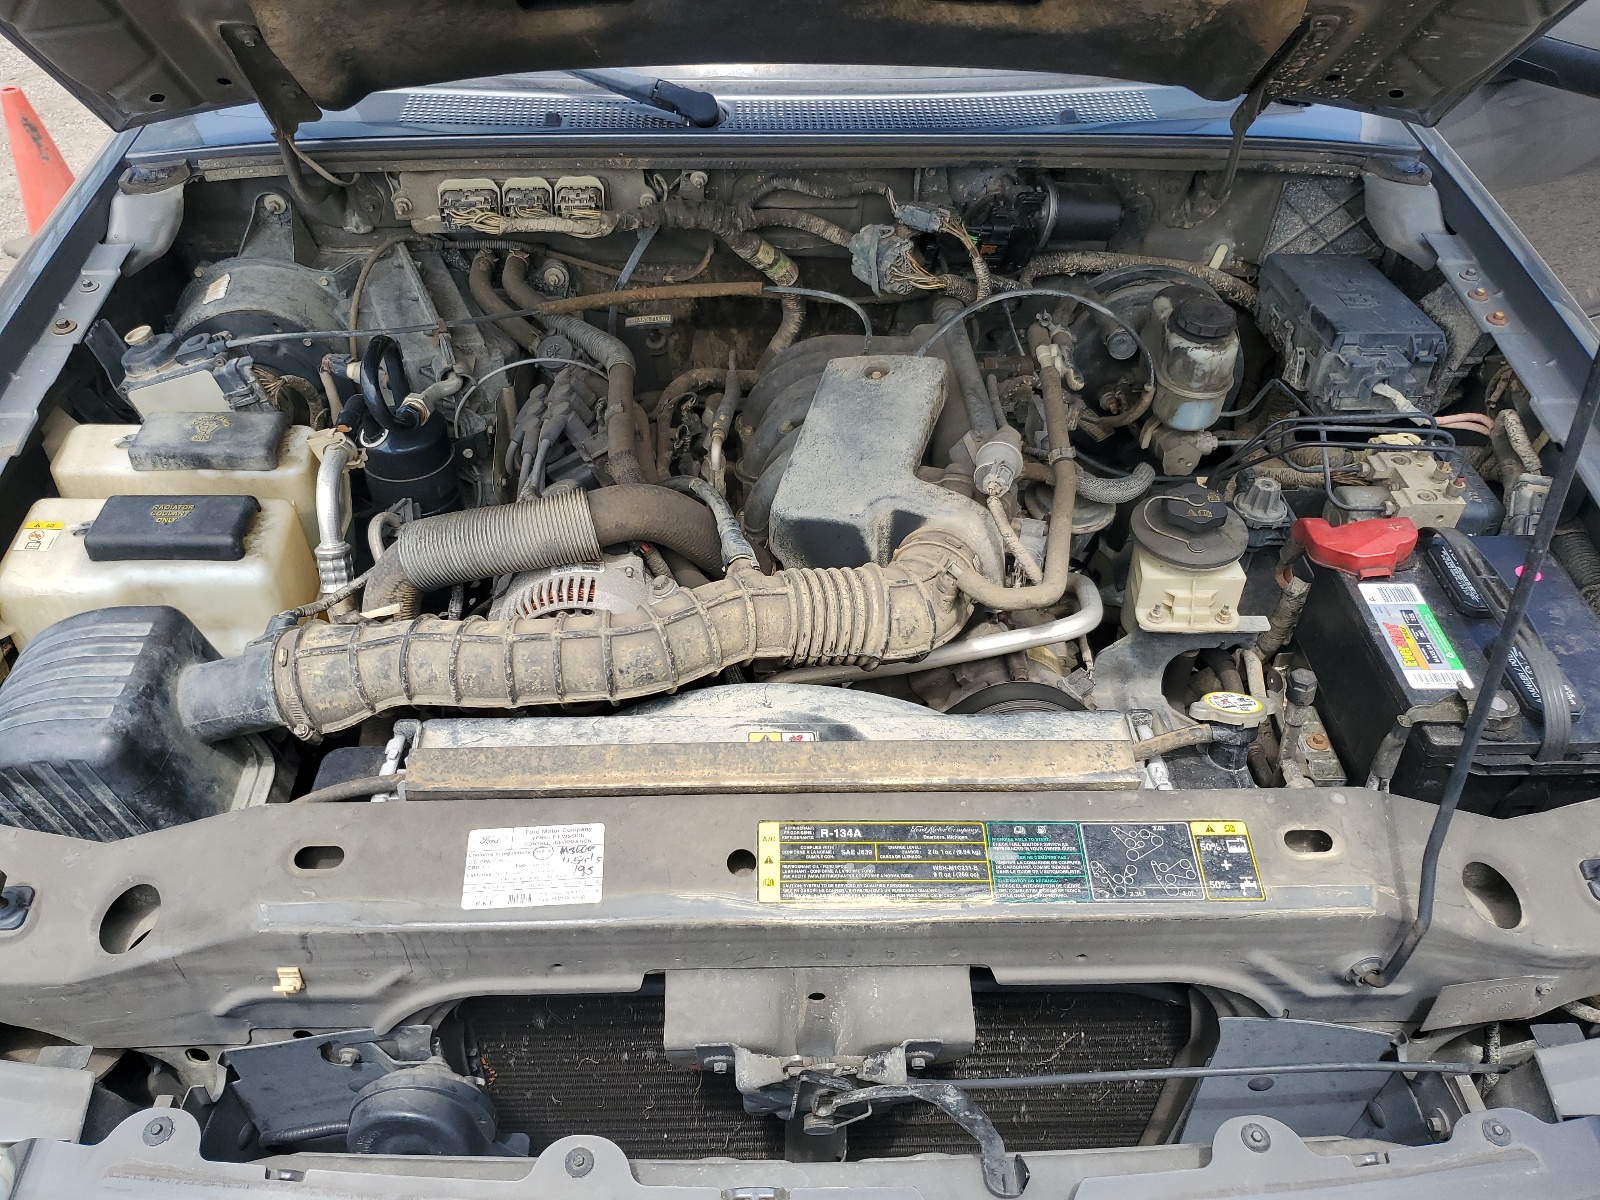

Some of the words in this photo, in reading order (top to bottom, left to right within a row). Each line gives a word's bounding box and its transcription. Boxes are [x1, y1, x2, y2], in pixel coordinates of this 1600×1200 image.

[820, 828, 863, 838] R-134A
[1200, 842, 1221, 852] 50%
[1208, 880, 1231, 890] 50%
